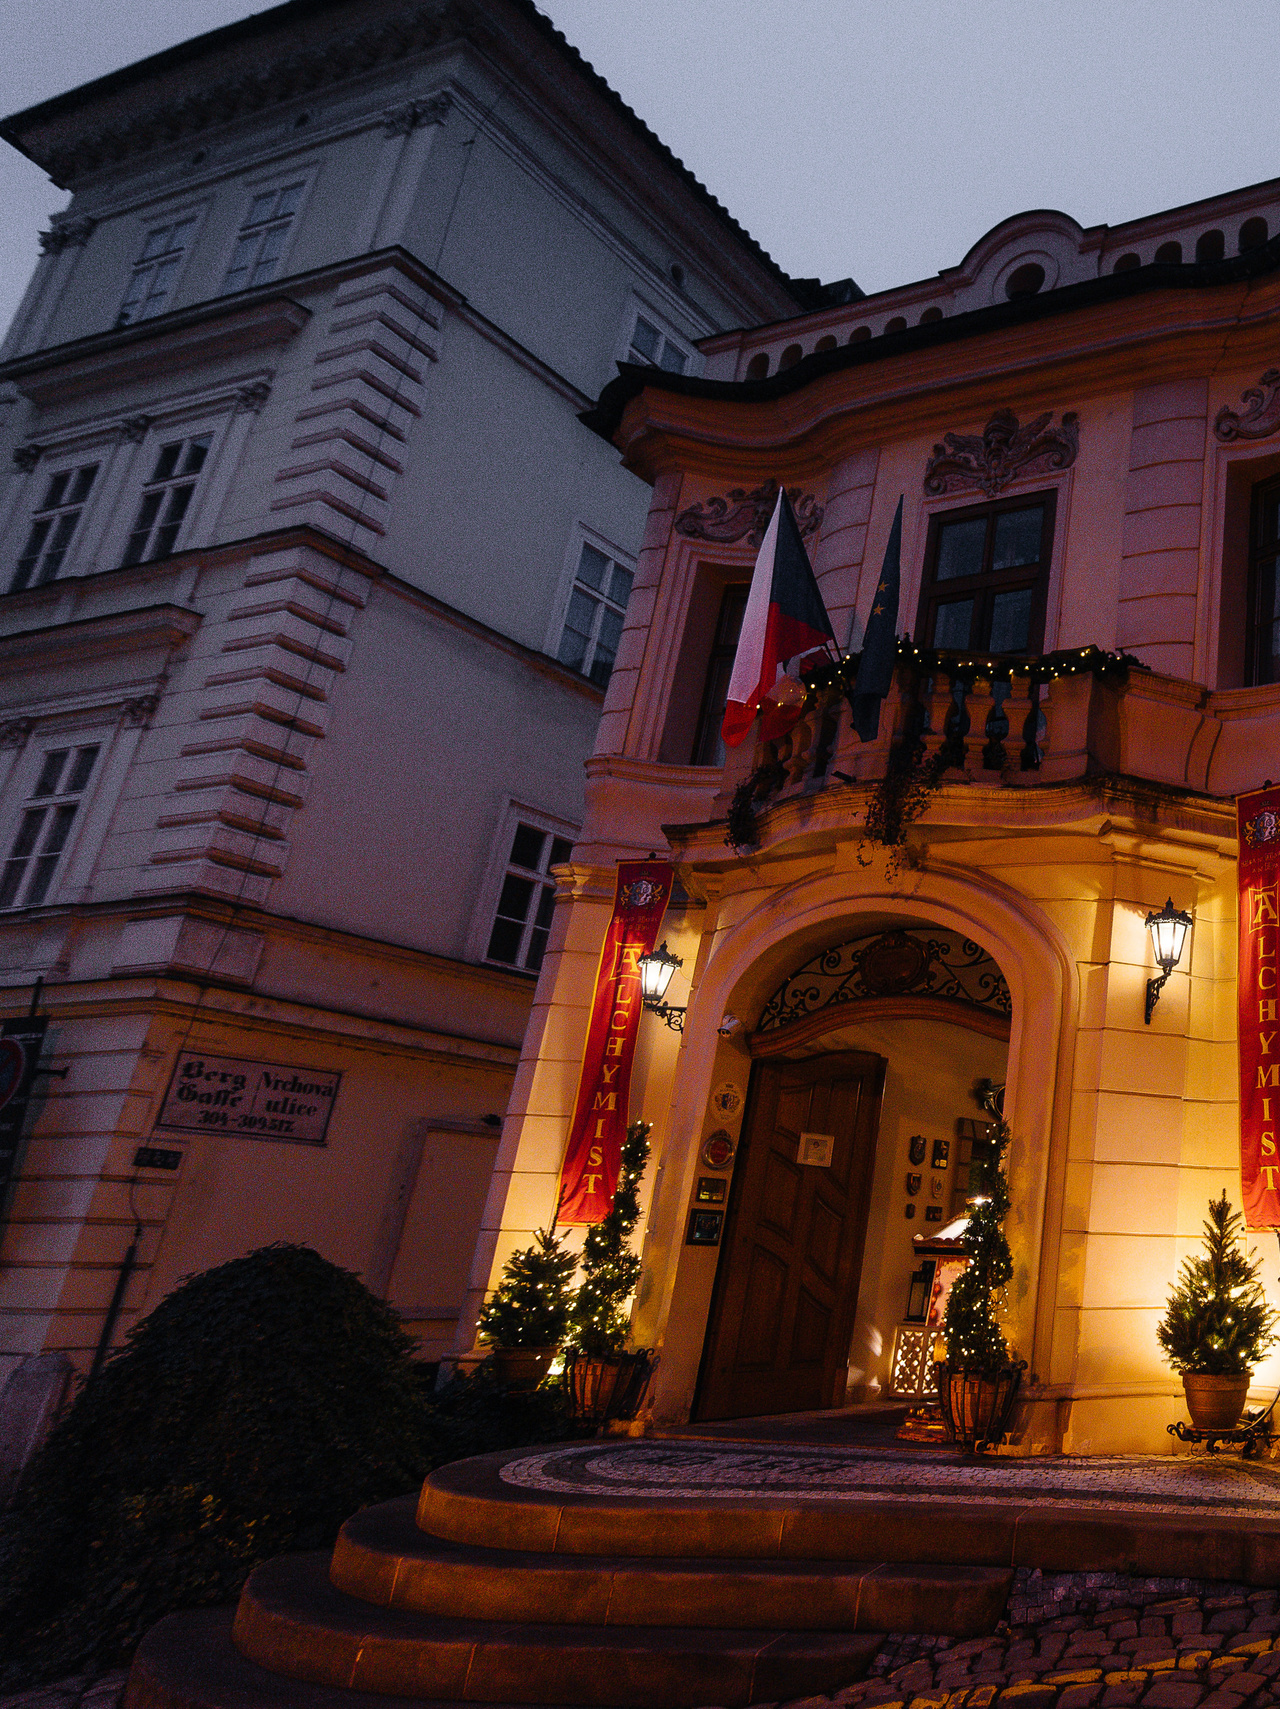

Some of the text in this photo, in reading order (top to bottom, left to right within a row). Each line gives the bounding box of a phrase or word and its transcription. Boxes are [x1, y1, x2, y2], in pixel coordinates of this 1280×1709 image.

[180, 1061, 247, 1092] Berg
[582, 947, 642, 1195] ALCHYMIST
[266, 1097, 318, 1117] ulice
